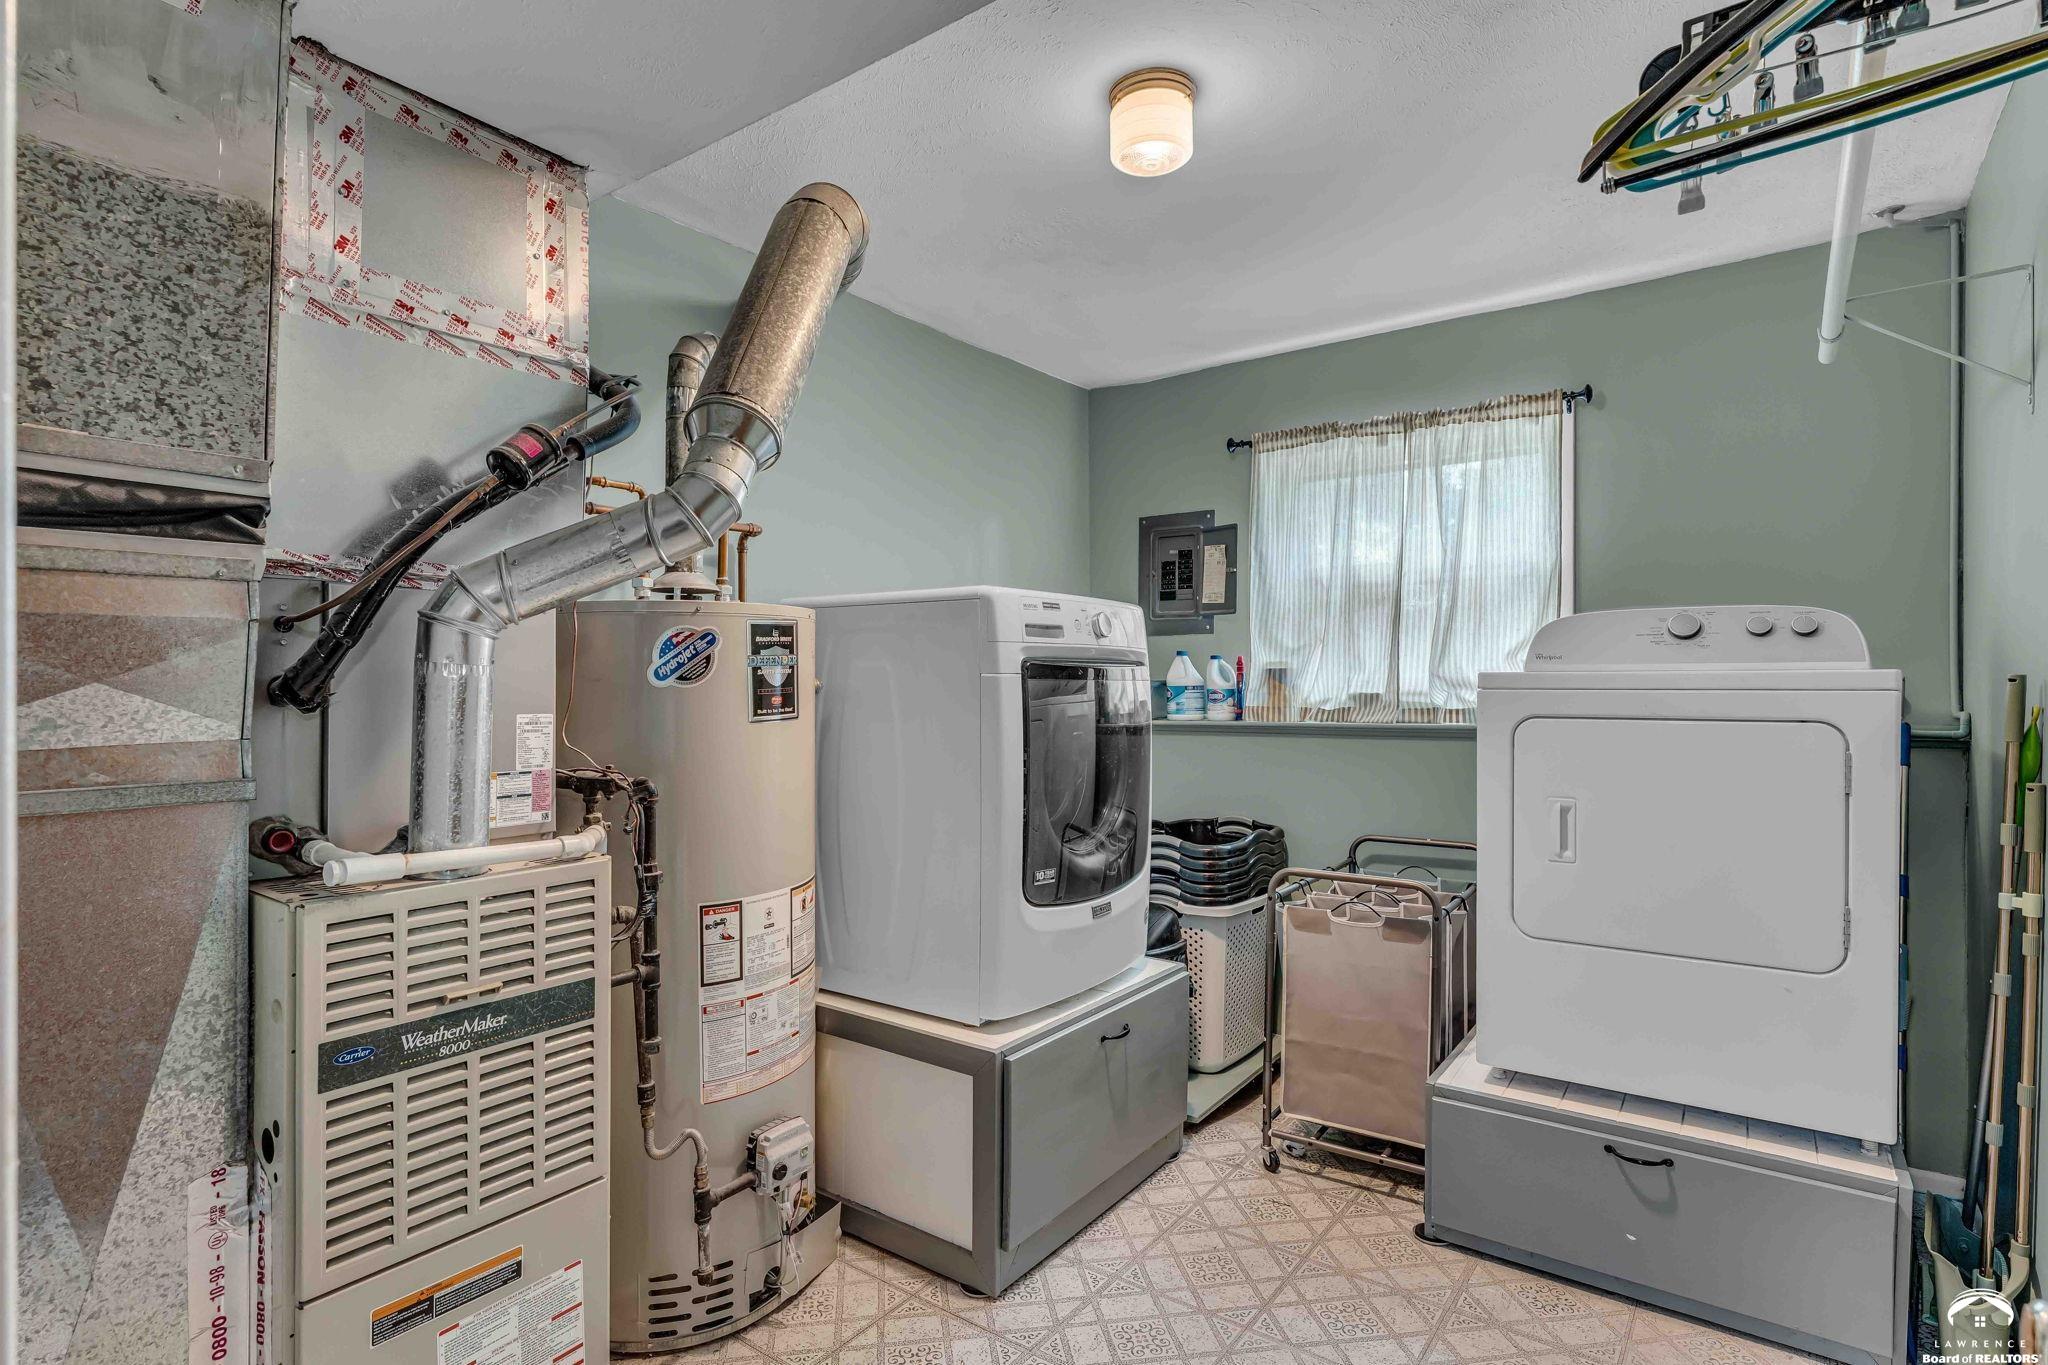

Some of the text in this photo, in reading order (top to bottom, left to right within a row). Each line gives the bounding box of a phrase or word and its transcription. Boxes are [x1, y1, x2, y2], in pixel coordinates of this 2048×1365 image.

[342, 76, 359, 91] 3M
[400, 103, 420, 123] 3M
[339, 124, 356, 145] 3M
[450, 127, 469, 146] 3M
[501, 148, 519, 166] 3M
[545, 198, 557, 214] 3M
[334, 234, 351, 254] 3M
[546, 245, 558, 261] 3M
[545, 287, 557, 304] 3M
[394, 298, 415, 315] 3M
[450, 313, 470, 329] 3M
[497, 327, 516, 343] 3M
[547, 334, 558, 349] 3M
[658, 644, 696, 676] Hydrojet
[748, 655, 797, 667] DEFENDER
[1535, 653, 1563, 661] Whirlpool
[715, 906, 736, 914] DANGER
[401, 1013, 508, 1051] WeatherMaker
[338, 1048, 371, 1062] Carrier
[439, 1039, 470, 1057] 8000
[209, 1265, 224, 1301] 10-98
[256, 1210, 265, 1345] FASSON 0800
[211, 1315, 226, 1359] 0800
